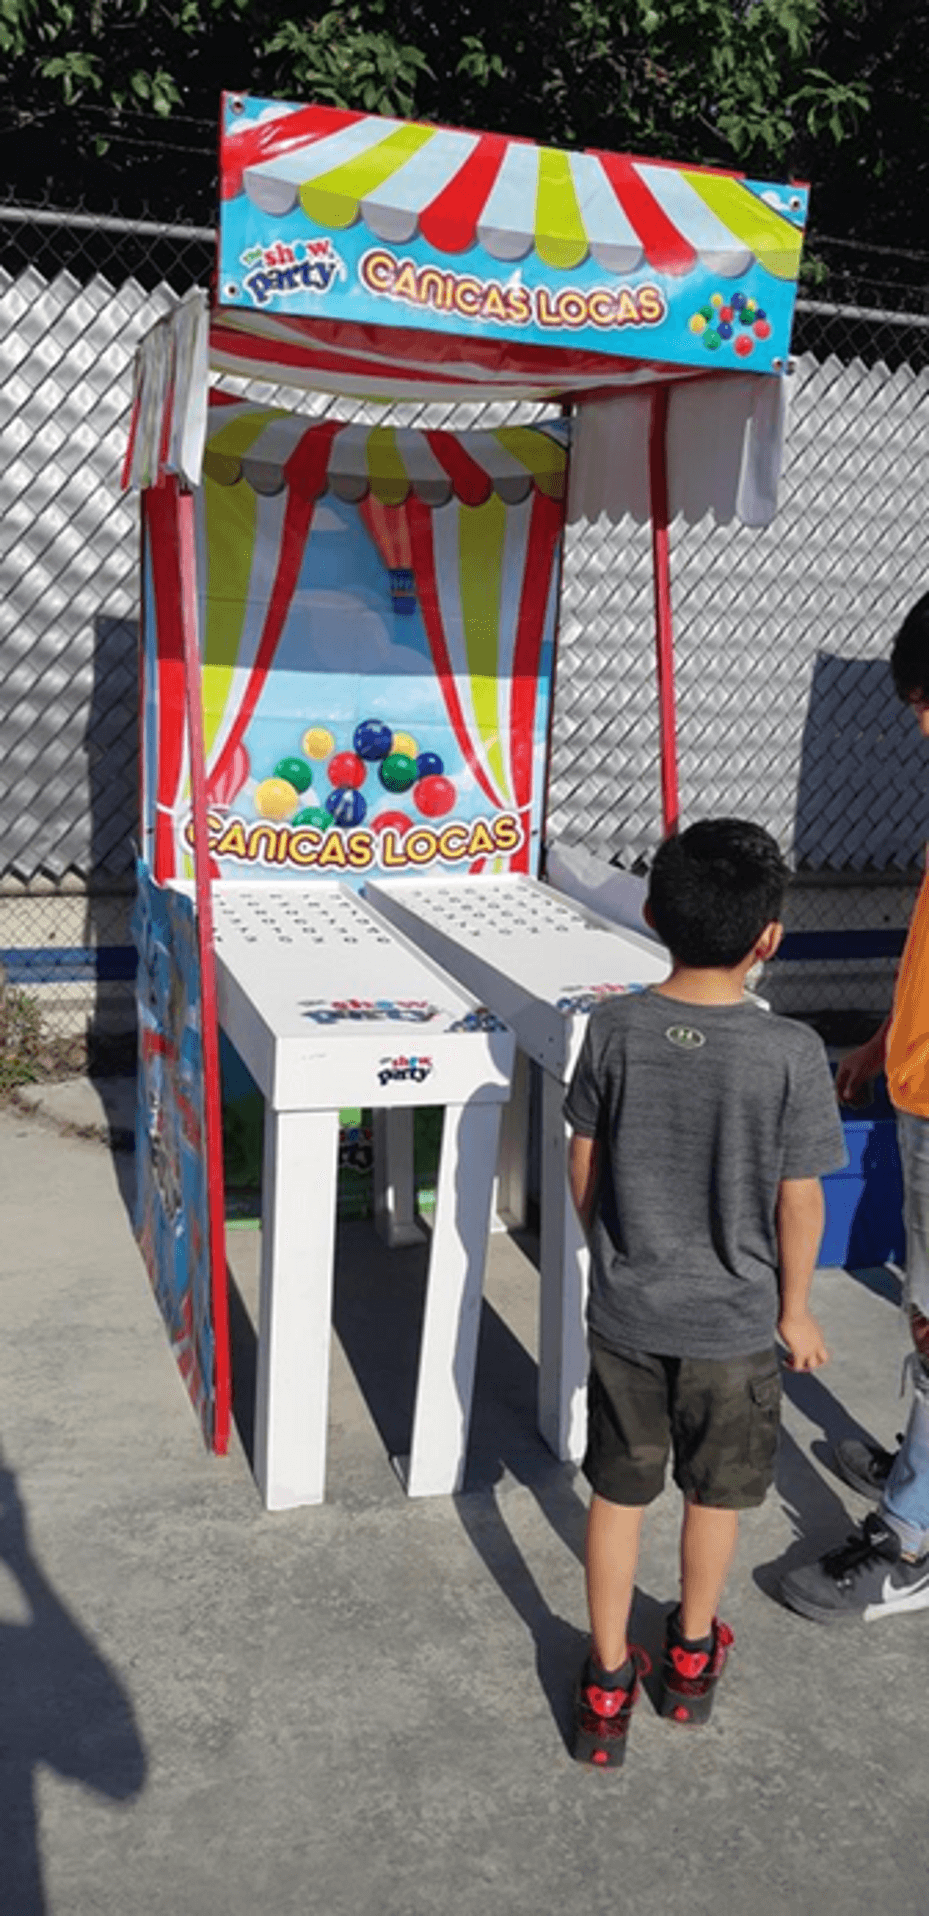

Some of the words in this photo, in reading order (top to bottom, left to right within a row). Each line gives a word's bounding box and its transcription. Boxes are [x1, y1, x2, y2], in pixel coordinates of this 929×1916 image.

[247, 262, 336, 303] party
[364, 253, 532, 323] CANICAS
[537, 284, 664, 327] LOCAS
[381, 815, 520, 868] LOCAS
[377, 1067, 431, 1085] party
